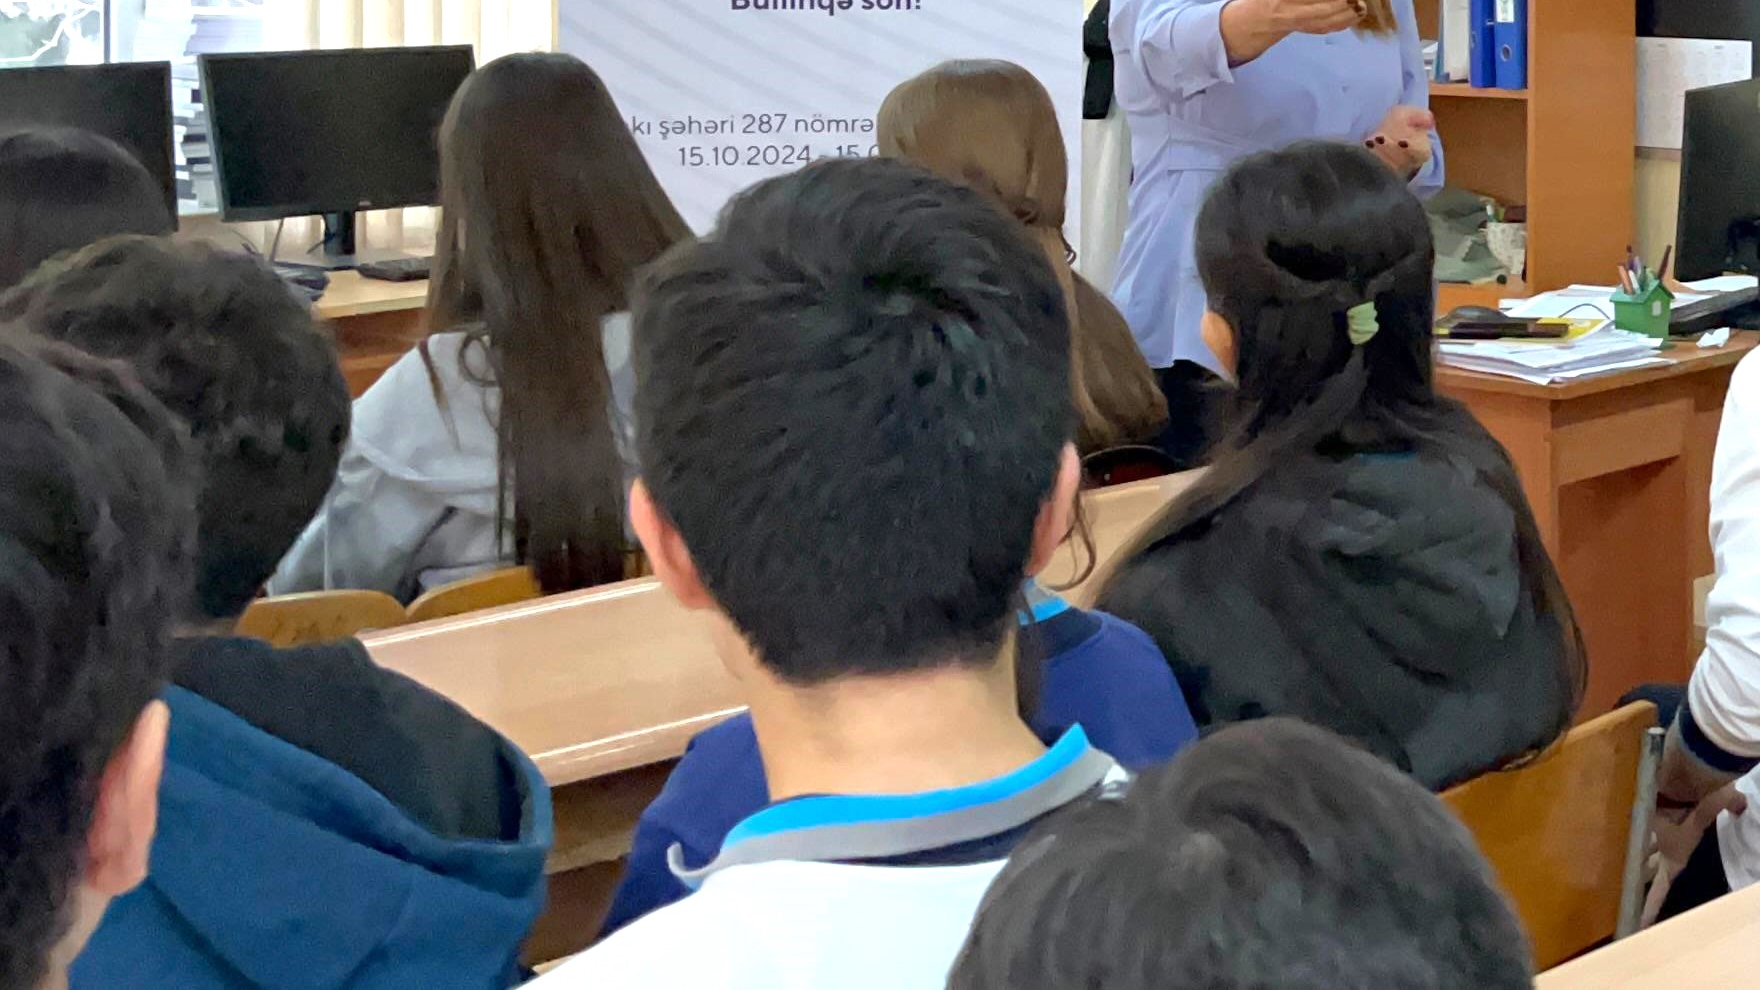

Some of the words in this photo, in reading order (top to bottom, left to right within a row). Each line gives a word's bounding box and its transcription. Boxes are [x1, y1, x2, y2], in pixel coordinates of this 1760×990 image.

[630, 115, 651, 135] kı
[659, 114, 735, 140] şəhəri
[742, 113, 787, 134] 287
[794, 114, 874, 133] nömrə
[678, 144, 811, 167] 15.10.2024
